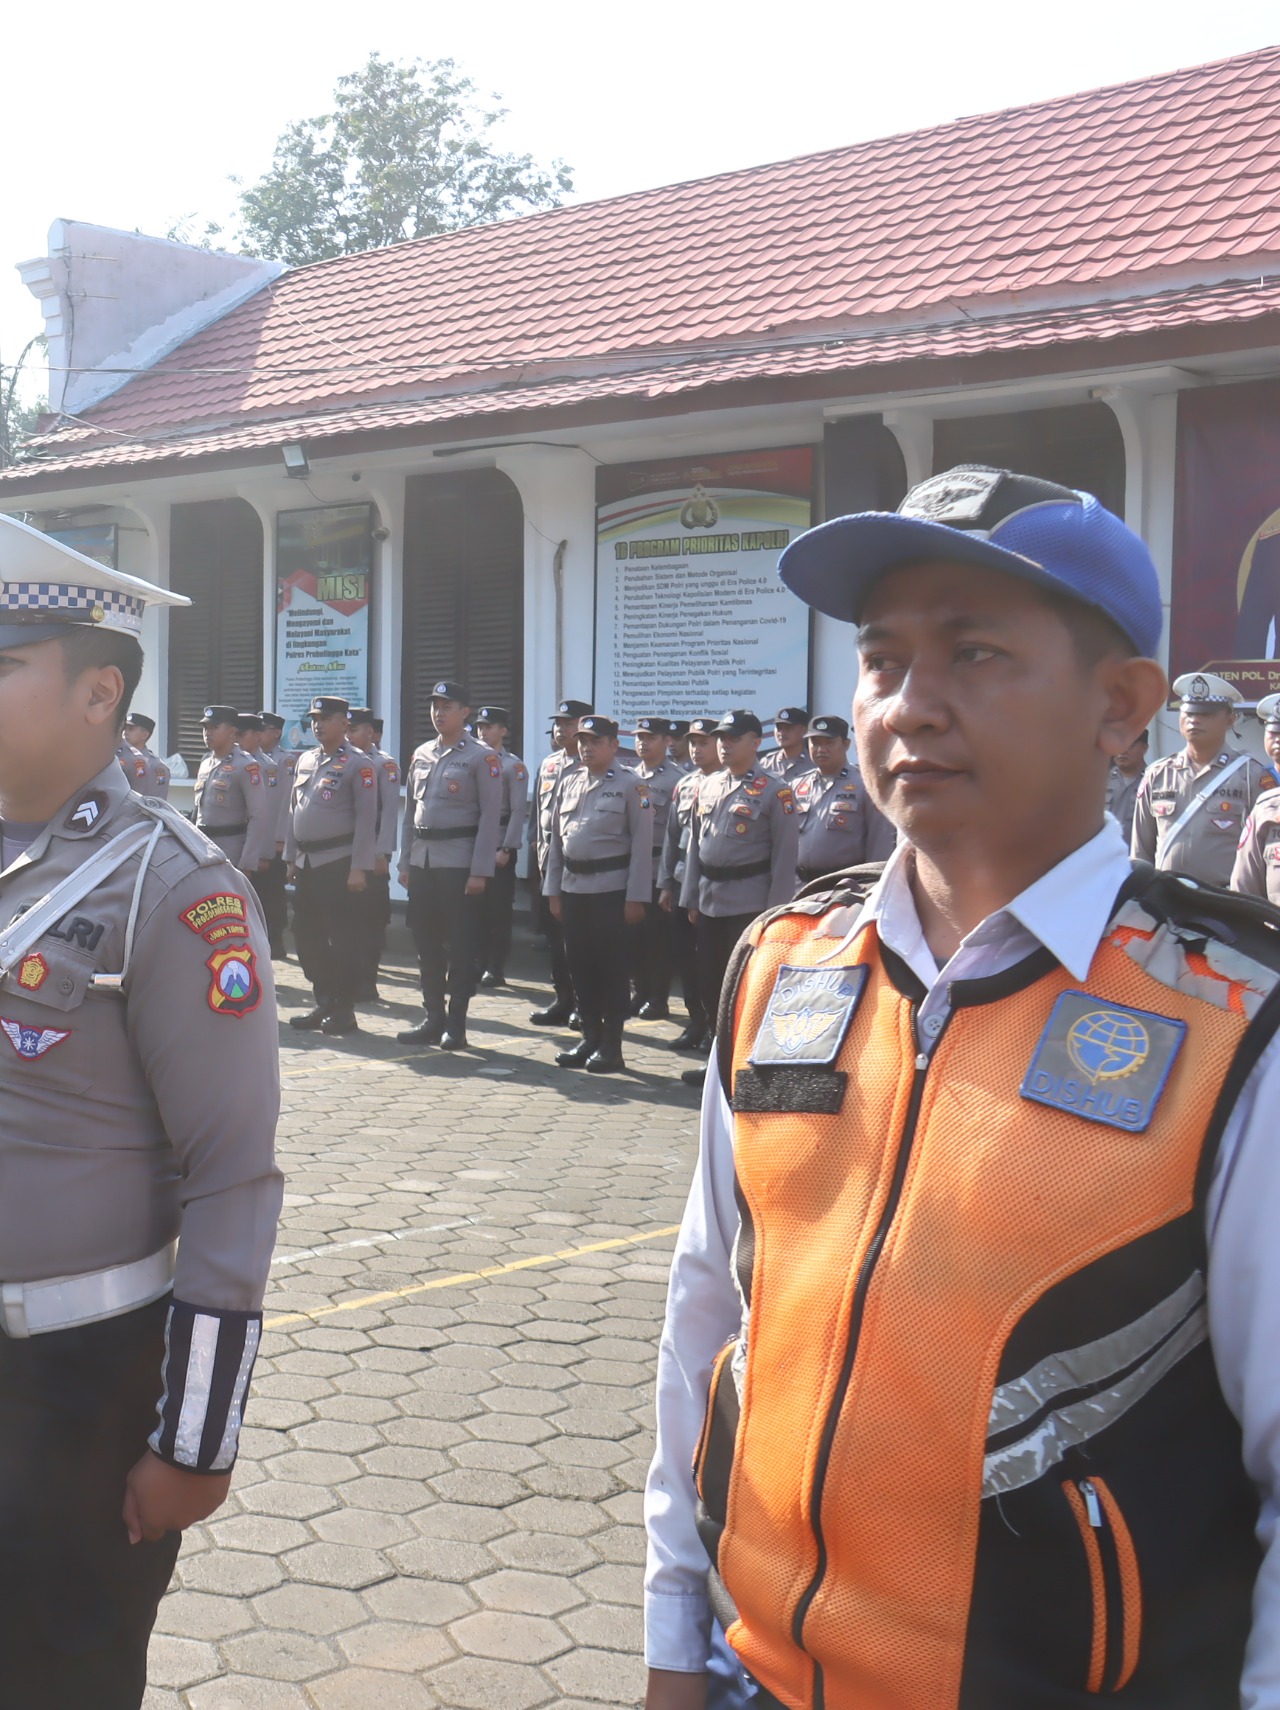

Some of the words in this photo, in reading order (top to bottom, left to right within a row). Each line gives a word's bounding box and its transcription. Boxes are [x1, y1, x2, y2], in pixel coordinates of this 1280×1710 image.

[629, 538, 681, 559] PROGRAM
[682, 534, 739, 555] PRIORITAS
[741, 529, 789, 551] KAPOLRI
[317, 574, 365, 601] MISI
[685, 581, 699, 590] yang
[739, 577, 757, 585] Police
[756, 586, 775, 594] Police
[712, 608, 733, 616] Hukum
[286, 618, 321, 628] Mengayomi
[286, 629, 313, 638] Melayani
[314, 628, 351, 637] Masyarakat
[293, 640, 327, 649] lingkungan
[681, 639, 705, 648] Program
[285, 651, 304, 659] Polres
[306, 650, 343, 659] Probolinggo
[297, 661, 325, 674] Makna
[325, 660, 346, 673] Misi
[1212, 789, 1243, 799] POLRI
[186, 896, 241, 922] POLRES
[1030, 1069, 1144, 1124] DISHUB
